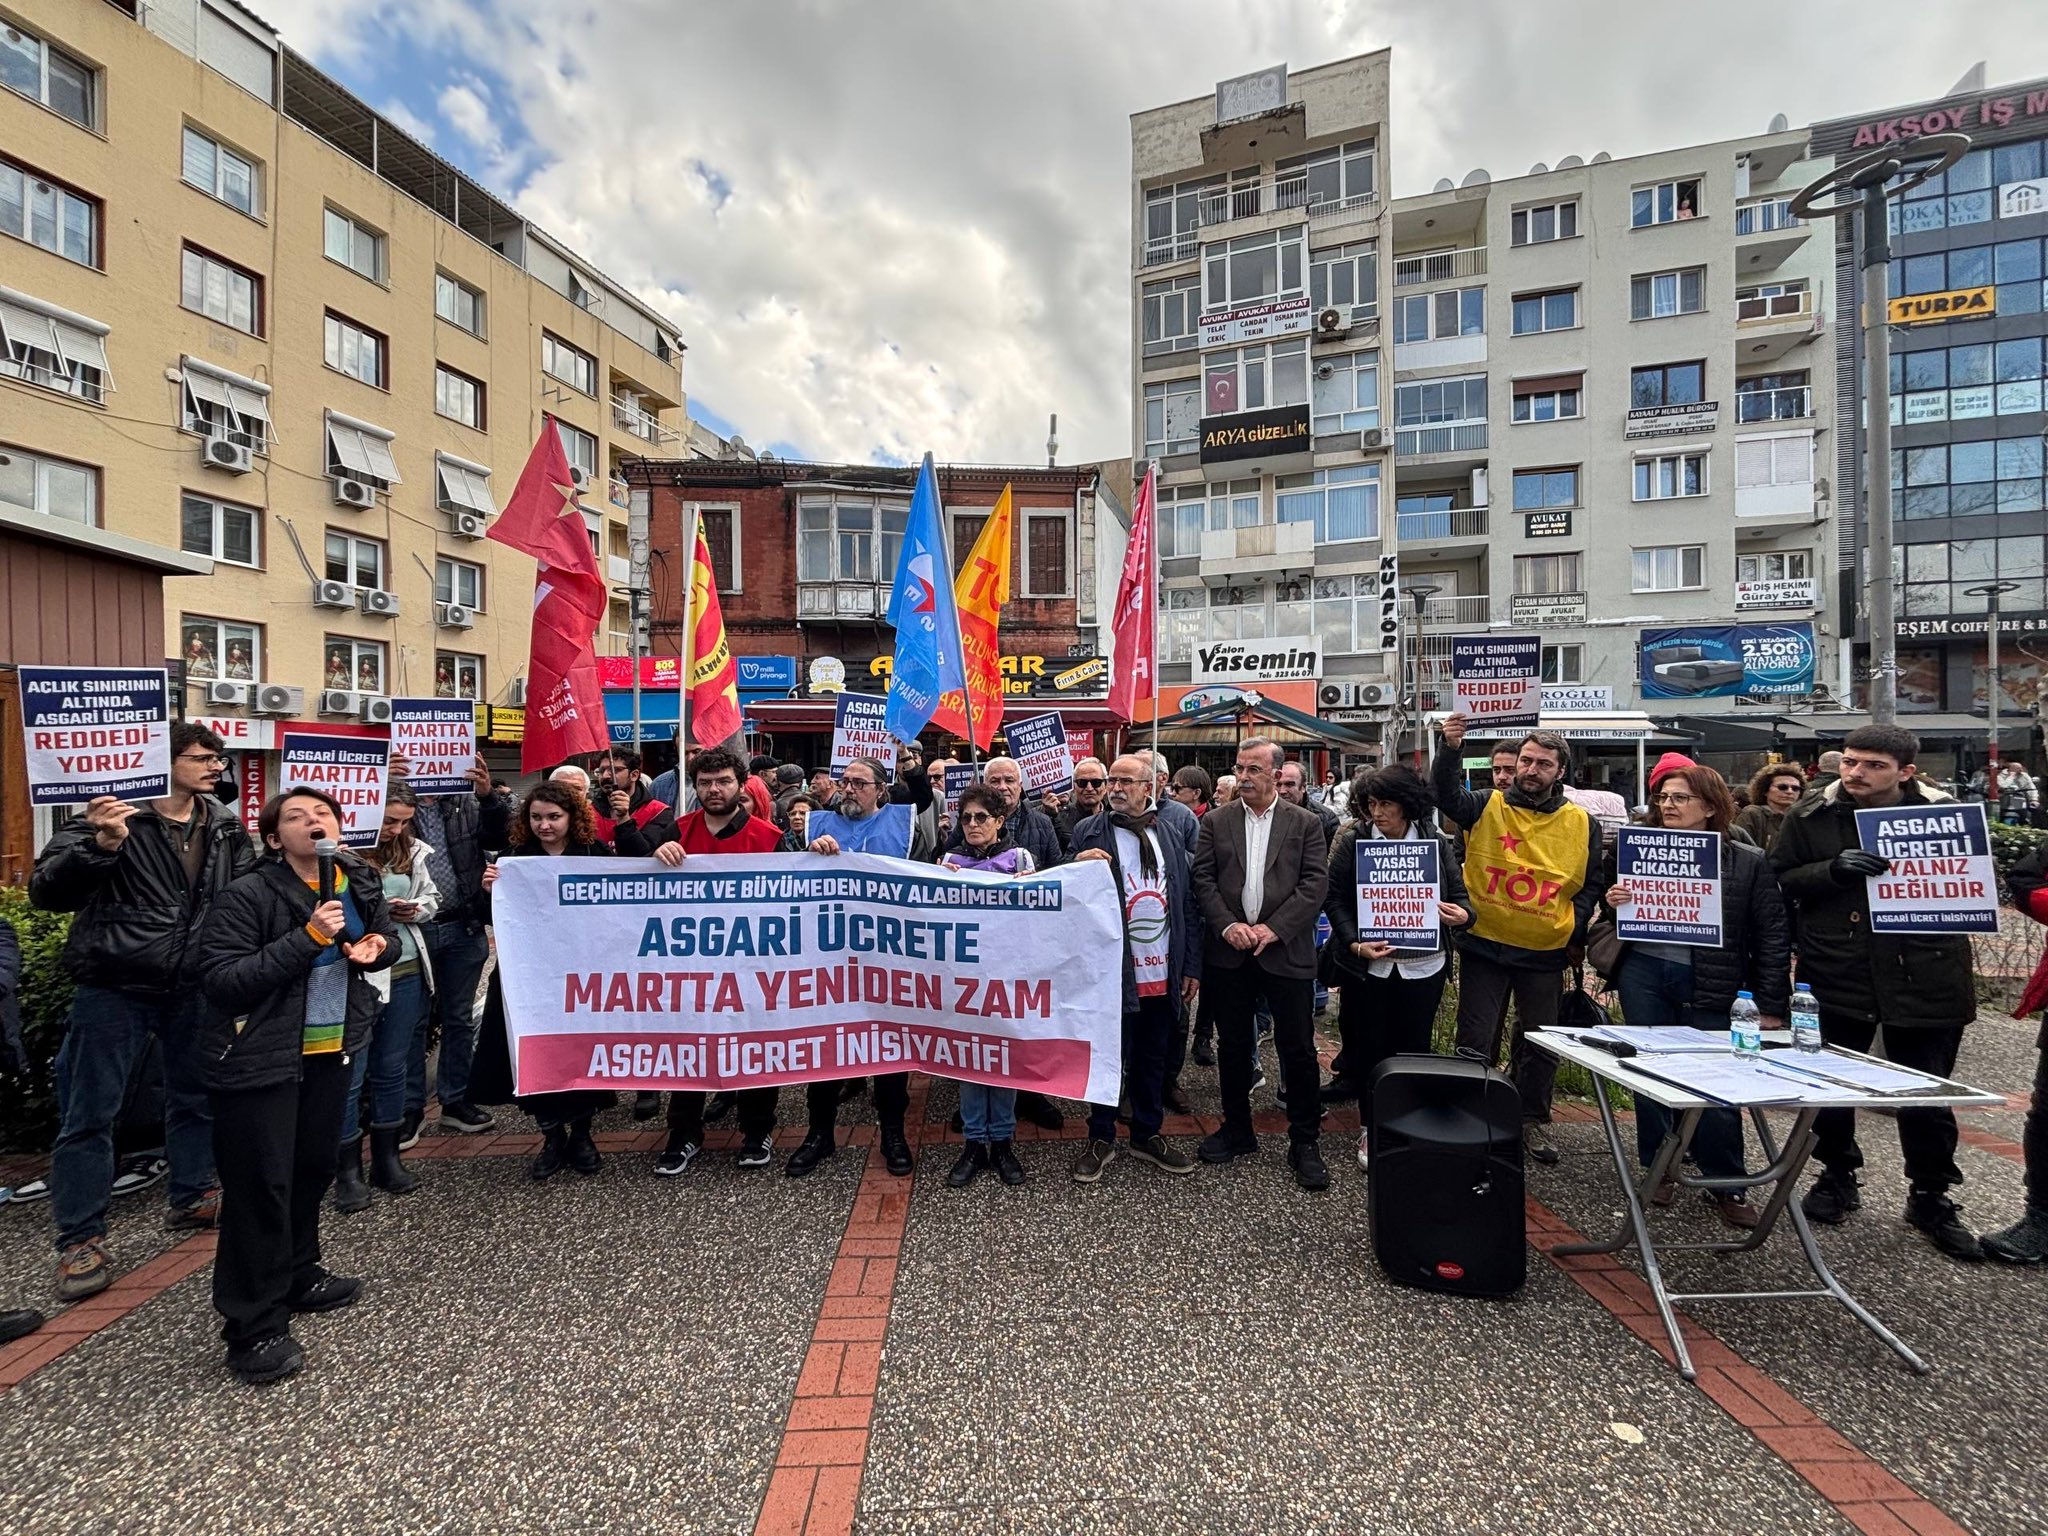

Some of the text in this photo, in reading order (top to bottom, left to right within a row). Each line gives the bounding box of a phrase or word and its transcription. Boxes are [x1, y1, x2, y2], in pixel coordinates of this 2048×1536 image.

[1852, 106, 1969, 148] AKSOY
[1238, 306, 1270, 318] AVUKAT
[1275, 300, 1308, 311] AVUKAT
[1202, 313, 1233, 324] AVUKAT
[1240, 318, 1268, 328] CANDAN
[1275, 312, 1293, 322] OSMAN
[1207, 325, 1227, 333] TELAT
[1284, 322, 1298, 330] SAAT
[1630, 410, 1660, 419] KAYAALP
[1203, 419, 1308, 449] ARYA GÜZELLİK
[1530, 513, 1567, 523] AVUKAT
[1773, 581, 1811, 590] HEKİMİ
[1380, 556, 1397, 648] KUAFÖR
[1514, 598, 1538, 606] ZEYDAN
[1539, 596, 1559, 605] HUKUK
[1741, 590, 1809, 602] Güray SAL
[1514, 606, 1576, 616] AVUKAT AVUKAT
[1894, 620, 1949, 638] EŞEM
[1213, 643, 1245, 654] Salon
[1456, 643, 1537, 656] AÇLIK SINIRININ
[655, 659, 675, 670] 800
[1082, 660, 1102, 677] Cafe
[1198, 647, 1318, 677] Yasemin
[1473, 656, 1517, 667] ALTINDA
[759, 666, 775, 674] milli
[760, 671, 787, 680] piyango
[1274, 670, 1289, 679] 323
[1290, 670, 1300, 678] 66
[1458, 665, 1534, 678] ASGARİ ÜCRETİ
[28, 681, 80, 694] AÇLIK
[83, 679, 160, 692] SINIRININ
[1457, 679, 1535, 696] REDDEDİ-
[899, 679, 932, 711] PARTİSİ
[62, 696, 133, 709] ALTINDA
[846, 701, 887, 716] ASGAR
[1468, 699, 1523, 713] YORUZ
[1560, 698, 1606, 709] & DOĞUM
[35, 707, 158, 725] ASGARİ ÜCRETİ
[395, 710, 432, 721] ASGARİ
[434, 711, 471, 721] ÜCRETE
[843, 714, 887, 731] ÜCRETL
[1479, 717, 1499, 725] ÜCRET
[398, 724, 469, 738] MARTTA
[1011, 716, 1055, 738] ASGARİ ÜCRET
[35, 724, 161, 750] REDDEDİ-
[845, 730, 888, 744] YALNIZ
[1019, 727, 1052, 745] YASASI
[396, 739, 471, 756] YENİDEN
[57, 752, 144, 773] YORUZ
[287, 749, 384, 764] ASGARİ ÜCRETE
[289, 765, 379, 783] MARTTA
[415, 761, 453, 776] ZAM
[1026, 760, 1063, 778] HAKKINI
[419, 778, 438, 787] ÜCRET
[1031, 769, 1064, 787] ALACAK
[37, 777, 164, 796] ASGARİ ÜCRET İNİSİYATİFİ
[248, 759, 259, 830] ECZANE
[1878, 812, 1966, 838] ASGARİ
[339, 832, 375, 842] NİSİYATİFİ
[1626, 835, 1709, 848] ASGARİ ÜCRET
[1364, 844, 1429, 857] ASGARİ ÜCRET
[1877, 835, 1973, 858] ÜCRETLİ
[1637, 847, 1695, 862] YASASI
[1373, 857, 1419, 869] YASASI
[1632, 861, 1701, 877] ÇIKACAK
[1888, 858, 1970, 876] YALNIZ
[1369, 870, 1425, 883] ÇIKACAK
[562, 875, 1059, 908] GEÇİNEBİLMEK VE BÜYÜMEDEN PAY ALABİMEK İÇİN
[1362, 885, 1434, 900] EMEKÇİLER
[1485, 865, 1563, 907] TÖP
[1623, 878, 1713, 896] EMEKÇİLER
[1878, 878, 1985, 900] DEĞİLDİR
[1371, 901, 1425, 913] HAKKINI
[1633, 893, 1701, 909] HAKKINI
[1373, 915, 1424, 928] ALACAK
[1635, 907, 1700, 922] ALACAK
[1876, 912, 1993, 923] ASGARİ ÜCRET İNİSİYATİFİ
[637, 903, 980, 963] ASGARİ ÜCRETE
[1361, 930, 1436, 939] ASGARİ ÜCRET İNİSİYATİFİ
[1621, 923, 1717, 936] ASGARİ ÜCRET İNİSİYATİFİ
[1144, 955, 1164, 967] SOL
[564, 956, 1051, 1019] MARTTA YENİDEN ZAM
[587, 1024, 1010, 1078] ASGARİ ÜCRET İNİSİYATİFİ
